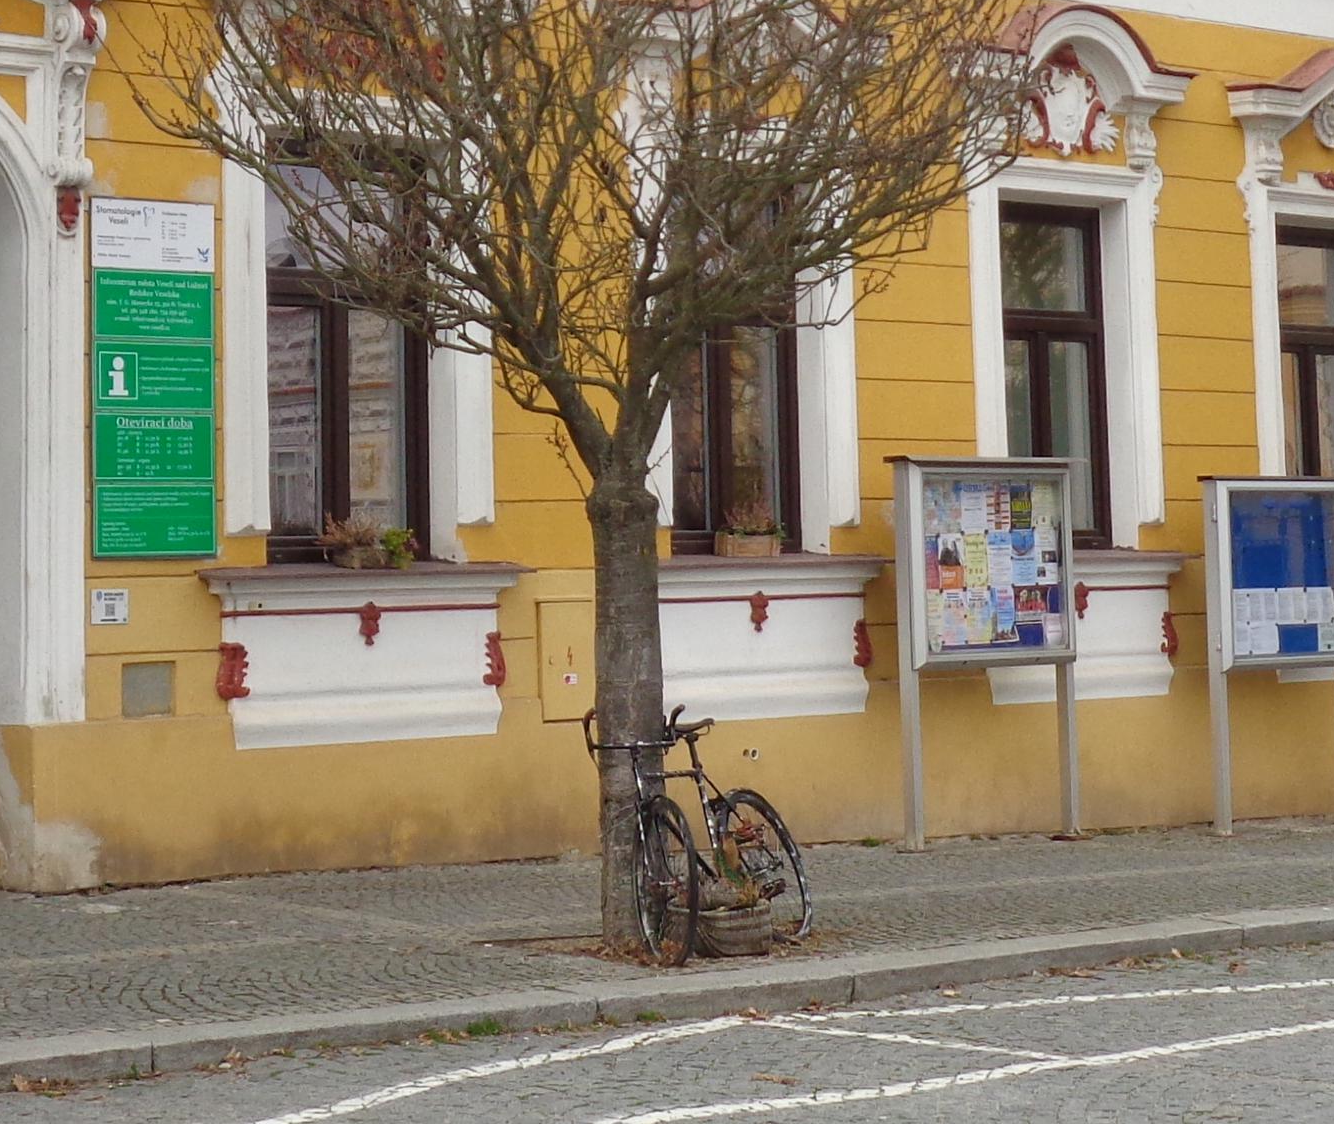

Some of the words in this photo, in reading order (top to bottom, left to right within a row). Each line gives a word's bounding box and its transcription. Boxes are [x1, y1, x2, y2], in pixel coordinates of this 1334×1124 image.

[96, 204, 142, 218] Stomatologie
[116, 416, 166, 428] Otevírací
[167, 416, 194, 429] doba
